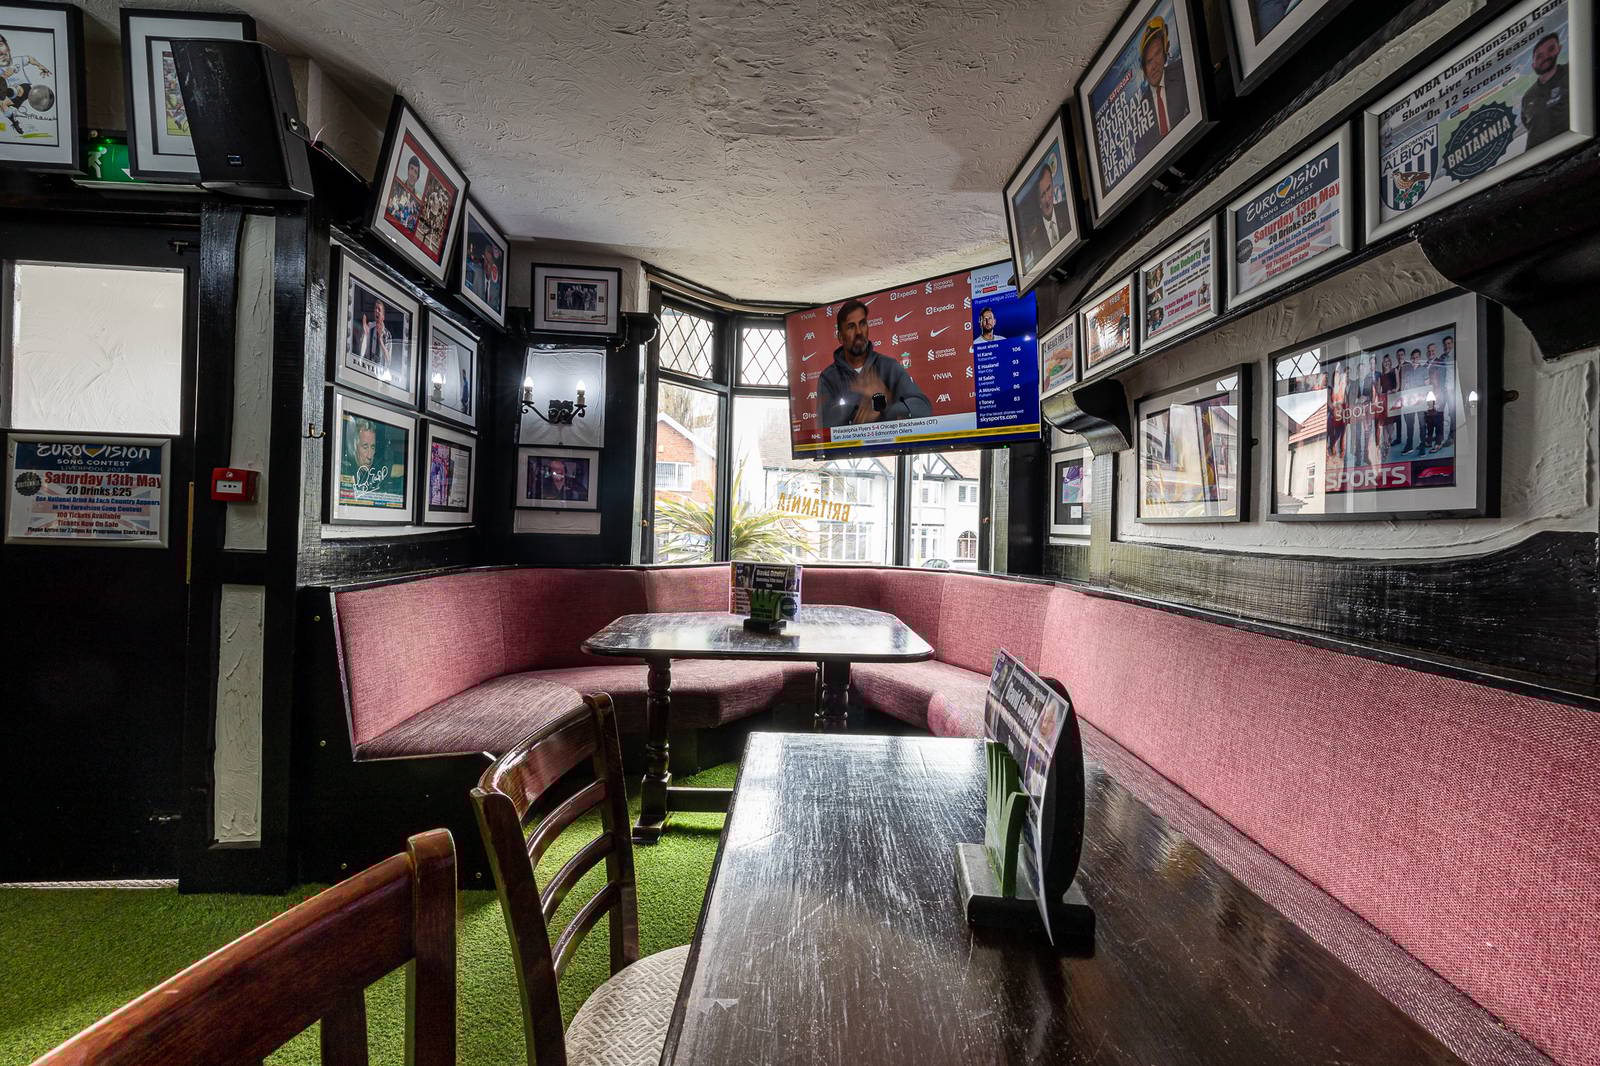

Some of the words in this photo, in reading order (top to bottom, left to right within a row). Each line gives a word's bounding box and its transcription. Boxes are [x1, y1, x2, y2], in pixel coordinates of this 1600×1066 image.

[1384, 98, 1411, 120] Every
[1414, 75, 1441, 99] WBA
[1444, 20, 1527, 80] Championship
[1402, 97, 1436, 121] Shown
[1439, 80, 1462, 99] Live
[1465, 59, 1493, 80] This
[1496, 26, 1545, 61] Season
[1426, 108, 1440, 120] On
[1445, 94, 1459, 110] 12
[1462, 63, 1512, 99] Screens
[1096, 91, 1127, 132] SOCCER
[1098, 87, 1143, 147] SATURDAY
[1100, 99, 1150, 159] EVACUATED
[1102, 149, 1118, 176] DUE
[1119, 136, 1131, 157] TO
[1133, 108, 1156, 144] FIRE
[1383, 134, 1435, 173] ALBION
[1447, 115, 1512, 169] BRITANNIA
[1104, 146, 1137, 189] ALARM!
[1253, 211, 1295, 244] Saturday
[1296, 196, 1318, 218] 13th
[1319, 181, 1341, 204] May
[1260, 206, 1279, 220] SONG
[1280, 182, 1314, 208] CONTEST
[1268, 232, 1278, 246] 20
[1278, 220, 1301, 240] Drinks
[1302, 210, 1317, 224] £25
[897, 290, 918, 298] Expedia
[934, 304, 954, 312] Expedia
[932, 372, 952, 380] YNWA
[936, 393, 951, 403] AXA
[1334, 398, 1384, 422] sports
[980, 414, 1017, 422] skysports.com
[44, 472, 104, 486] Saturday
[106, 474, 134, 486] 13th
[136, 474, 161, 488] May
[66, 486, 78, 495] 20
[80, 486, 110, 496] Drinks
[112, 487, 132, 497] £25
[1326, 466, 1406, 490] SPORTS
